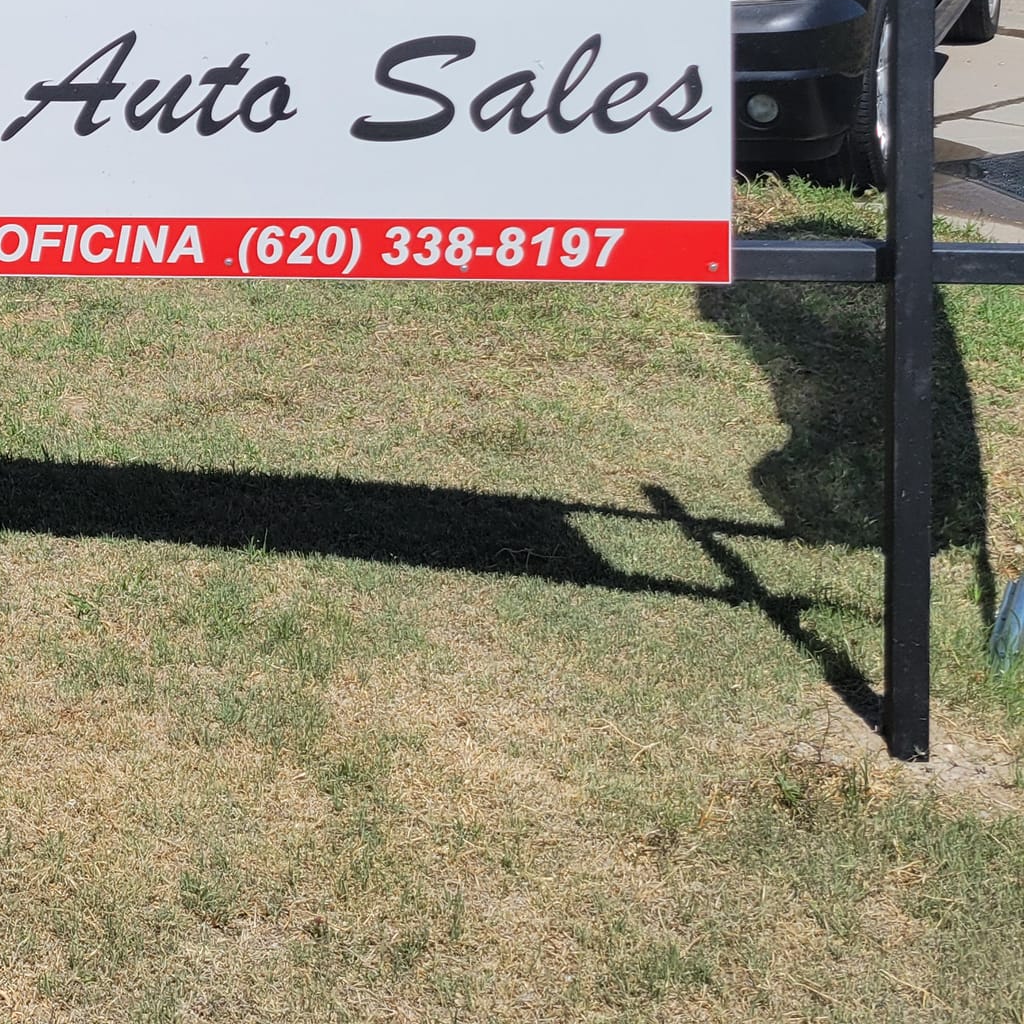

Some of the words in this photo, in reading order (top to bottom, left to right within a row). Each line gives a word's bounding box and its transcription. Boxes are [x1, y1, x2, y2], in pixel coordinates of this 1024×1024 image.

[0, 30, 298, 143] Auto
[350, 33, 713, 143] Sales
[238, 225, 362, 275] (620)
[381, 225, 625, 269] 338-8197
